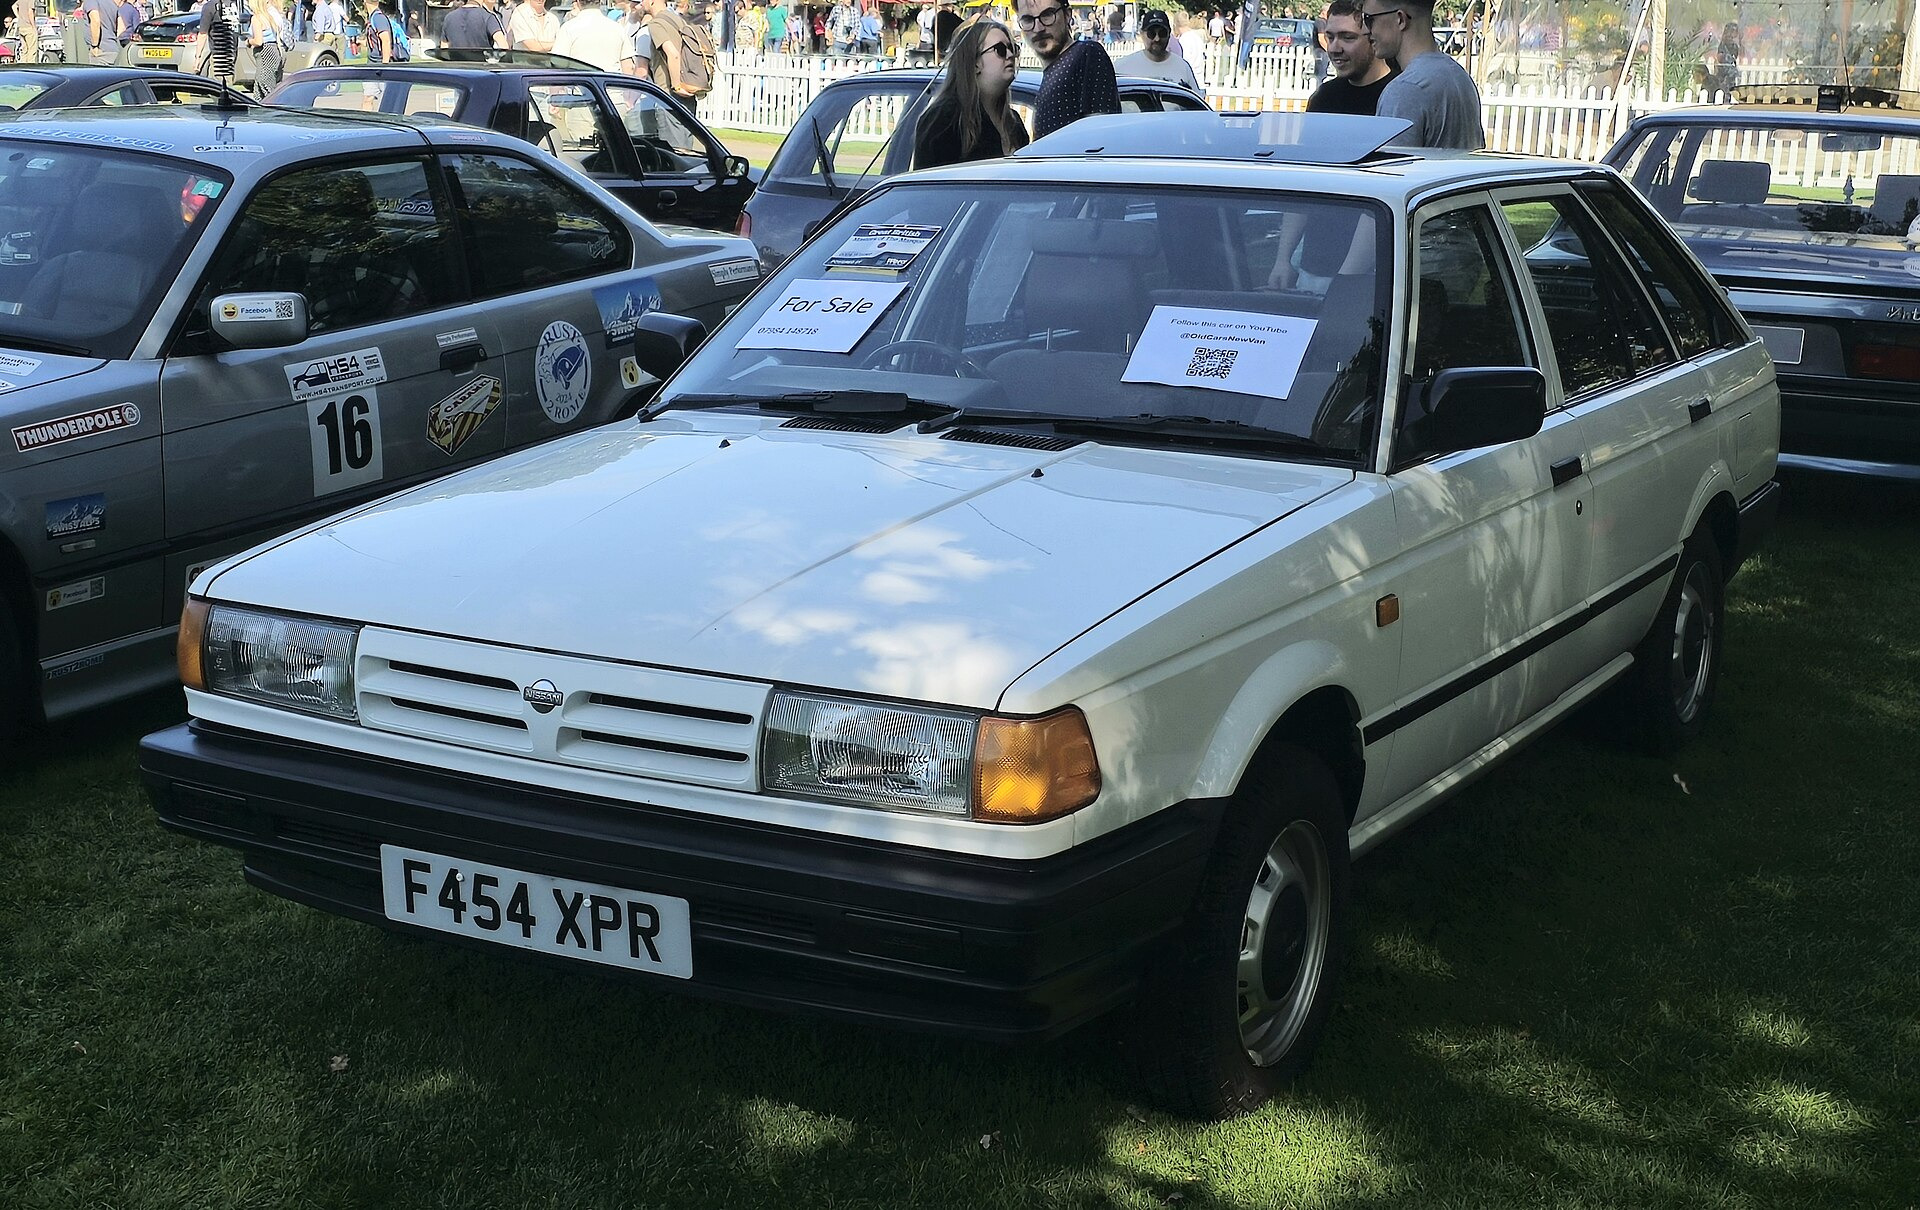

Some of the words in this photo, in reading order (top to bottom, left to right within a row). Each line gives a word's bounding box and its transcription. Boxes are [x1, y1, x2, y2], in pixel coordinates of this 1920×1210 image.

[779, 296, 822, 312] For
[822, 297, 874, 314] Sale
[543, 323, 581, 348] RUST
[1170, 318, 1200, 326] Follow
[1249, 324, 1288, 334] YouTube
[1180, 332, 1266, 345] @OldCarsNewVan
[326, 355, 360, 375] HS4
[16, 408, 122, 447] THUNDERPOLE
[317, 394, 374, 475] 16
[525, 688, 561, 704] NISSAN
[402, 858, 537, 939] F454
[552, 887, 663, 963] XPR
